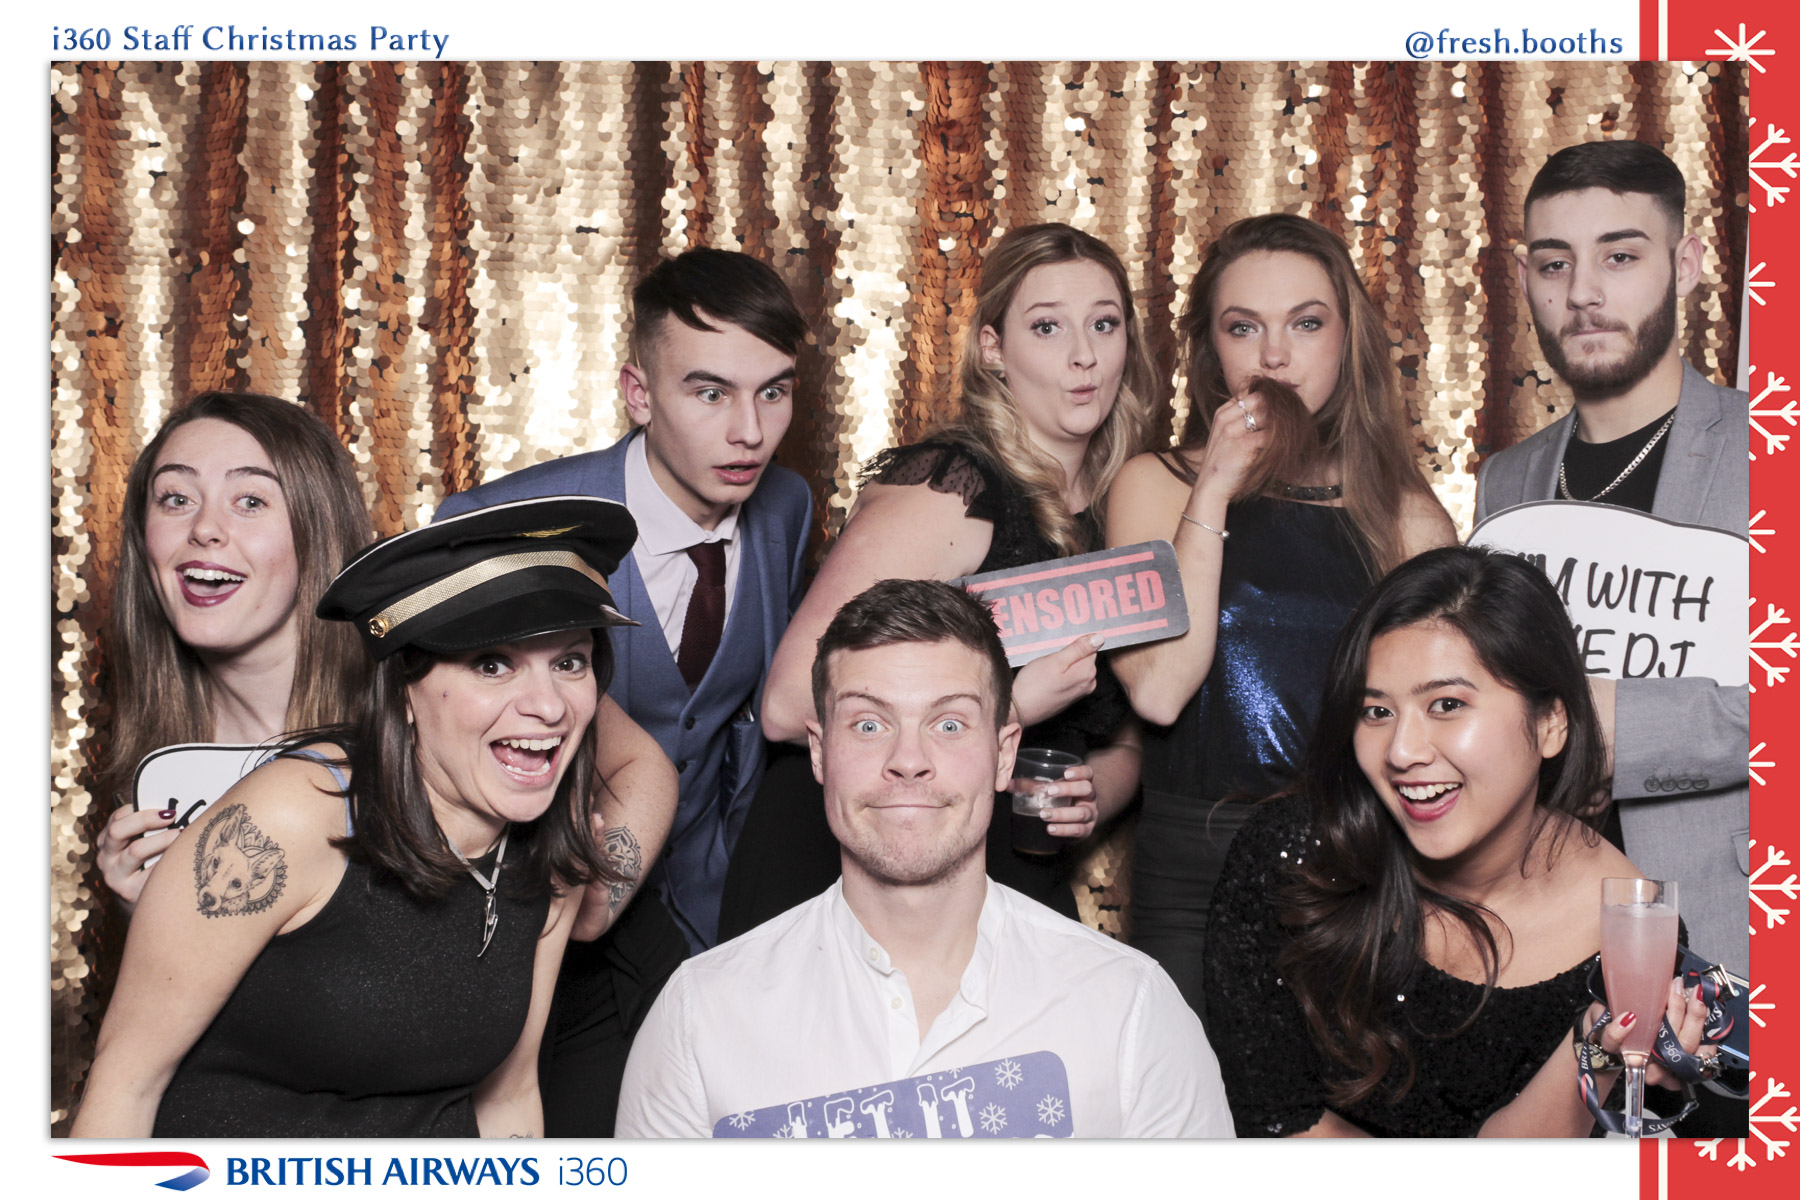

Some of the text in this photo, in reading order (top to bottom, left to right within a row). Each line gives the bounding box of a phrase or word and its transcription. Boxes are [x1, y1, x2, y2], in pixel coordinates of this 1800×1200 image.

[990, 570, 1166, 638] ENSORED
[1517, 552, 1714, 622] 'M WITH
[1622, 632, 1696, 678] DJ
[1663, 1040, 1682, 1063] i360
[916, 1076, 975, 1138] IT
